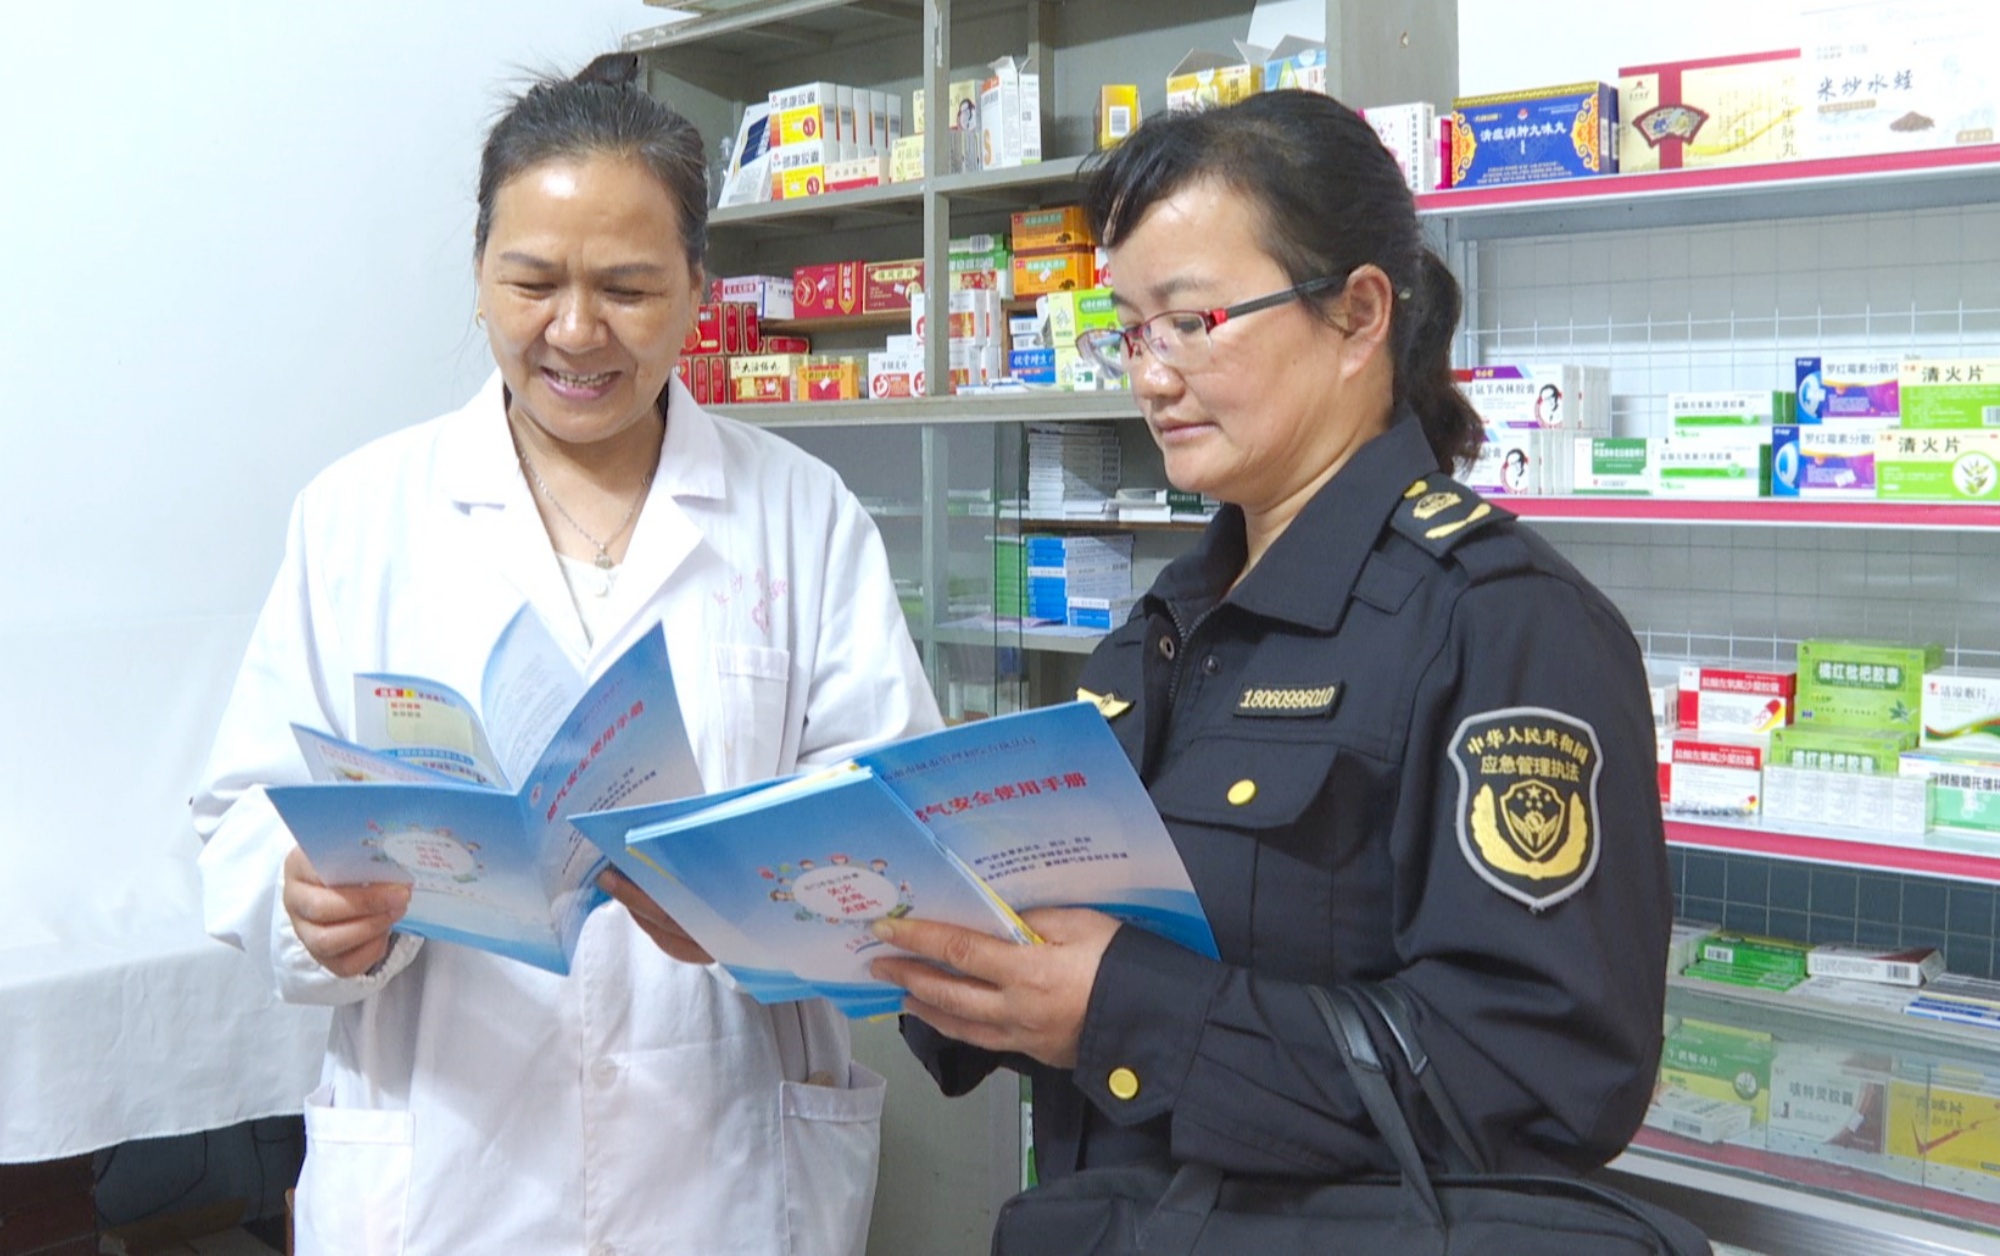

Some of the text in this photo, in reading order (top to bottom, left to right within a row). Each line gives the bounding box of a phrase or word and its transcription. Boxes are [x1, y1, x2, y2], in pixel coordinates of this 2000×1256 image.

[1817, 69, 1914, 101] 米炒水蛭
[1922, 365, 1984, 383] 清火片
[1898, 436, 1961, 453] 清火片
[1467, 726, 1589, 765] 中华人民共和国
[1481, 755, 1580, 782] 应急管理执法
